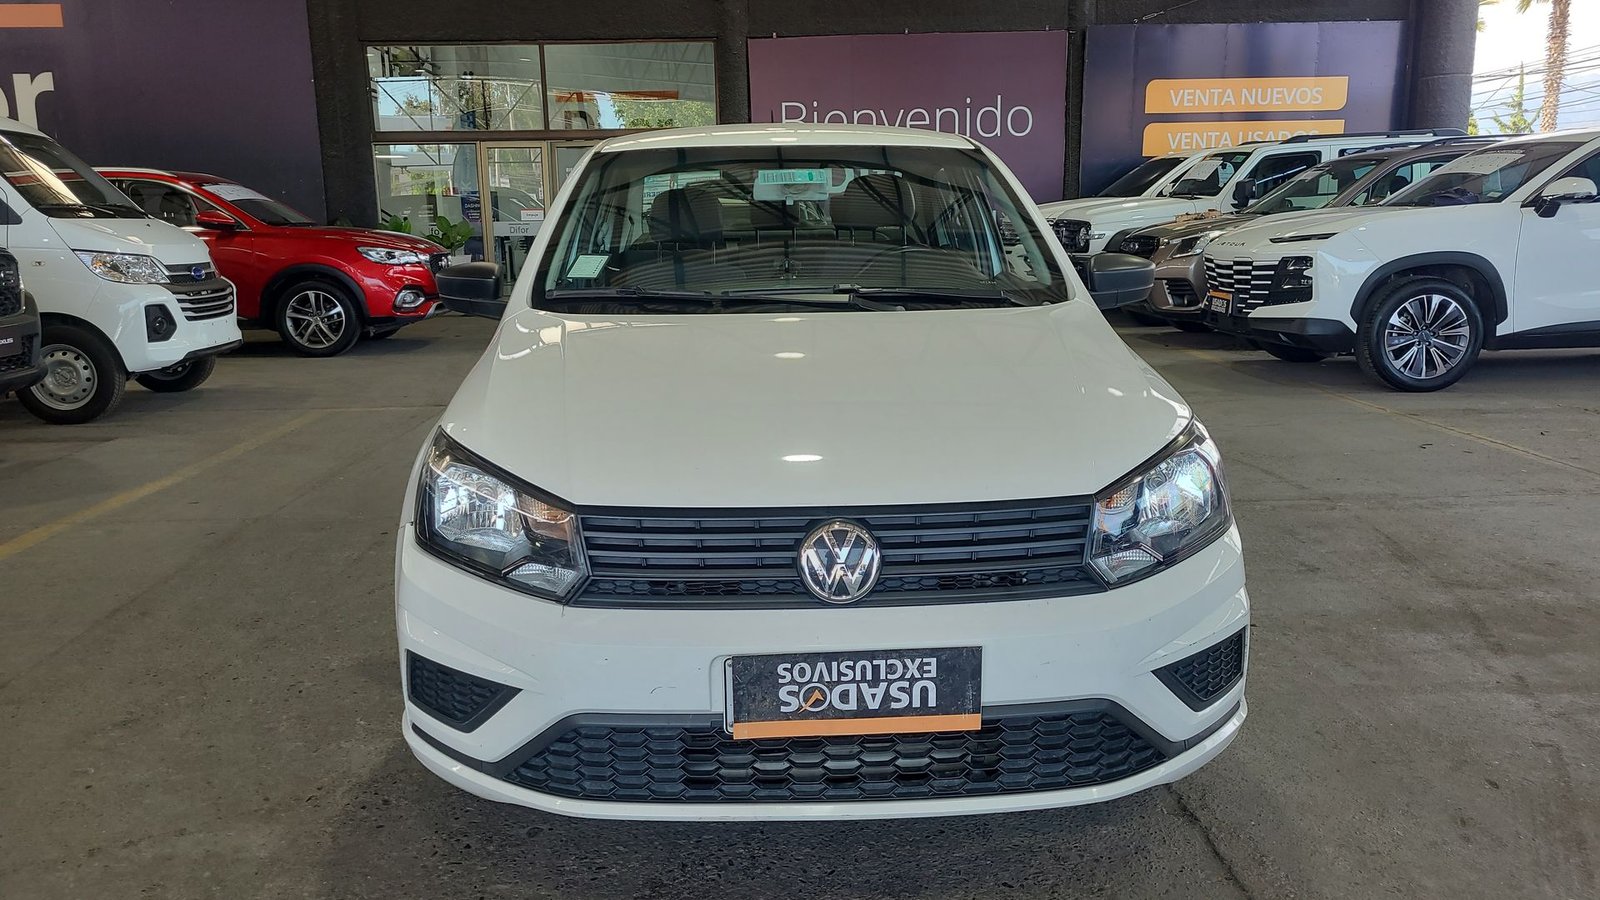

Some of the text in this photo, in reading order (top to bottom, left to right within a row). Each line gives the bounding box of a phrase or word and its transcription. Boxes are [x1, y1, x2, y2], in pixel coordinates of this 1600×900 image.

[1169, 87, 1323, 107] VENTA NUEVOS
[1167, 131, 1234, 150] VENTA
[509, 226, 530, 234] Difor
[777, 657, 937, 684] EXCLUSIVOS
[778, 680, 937, 713] USADOS
